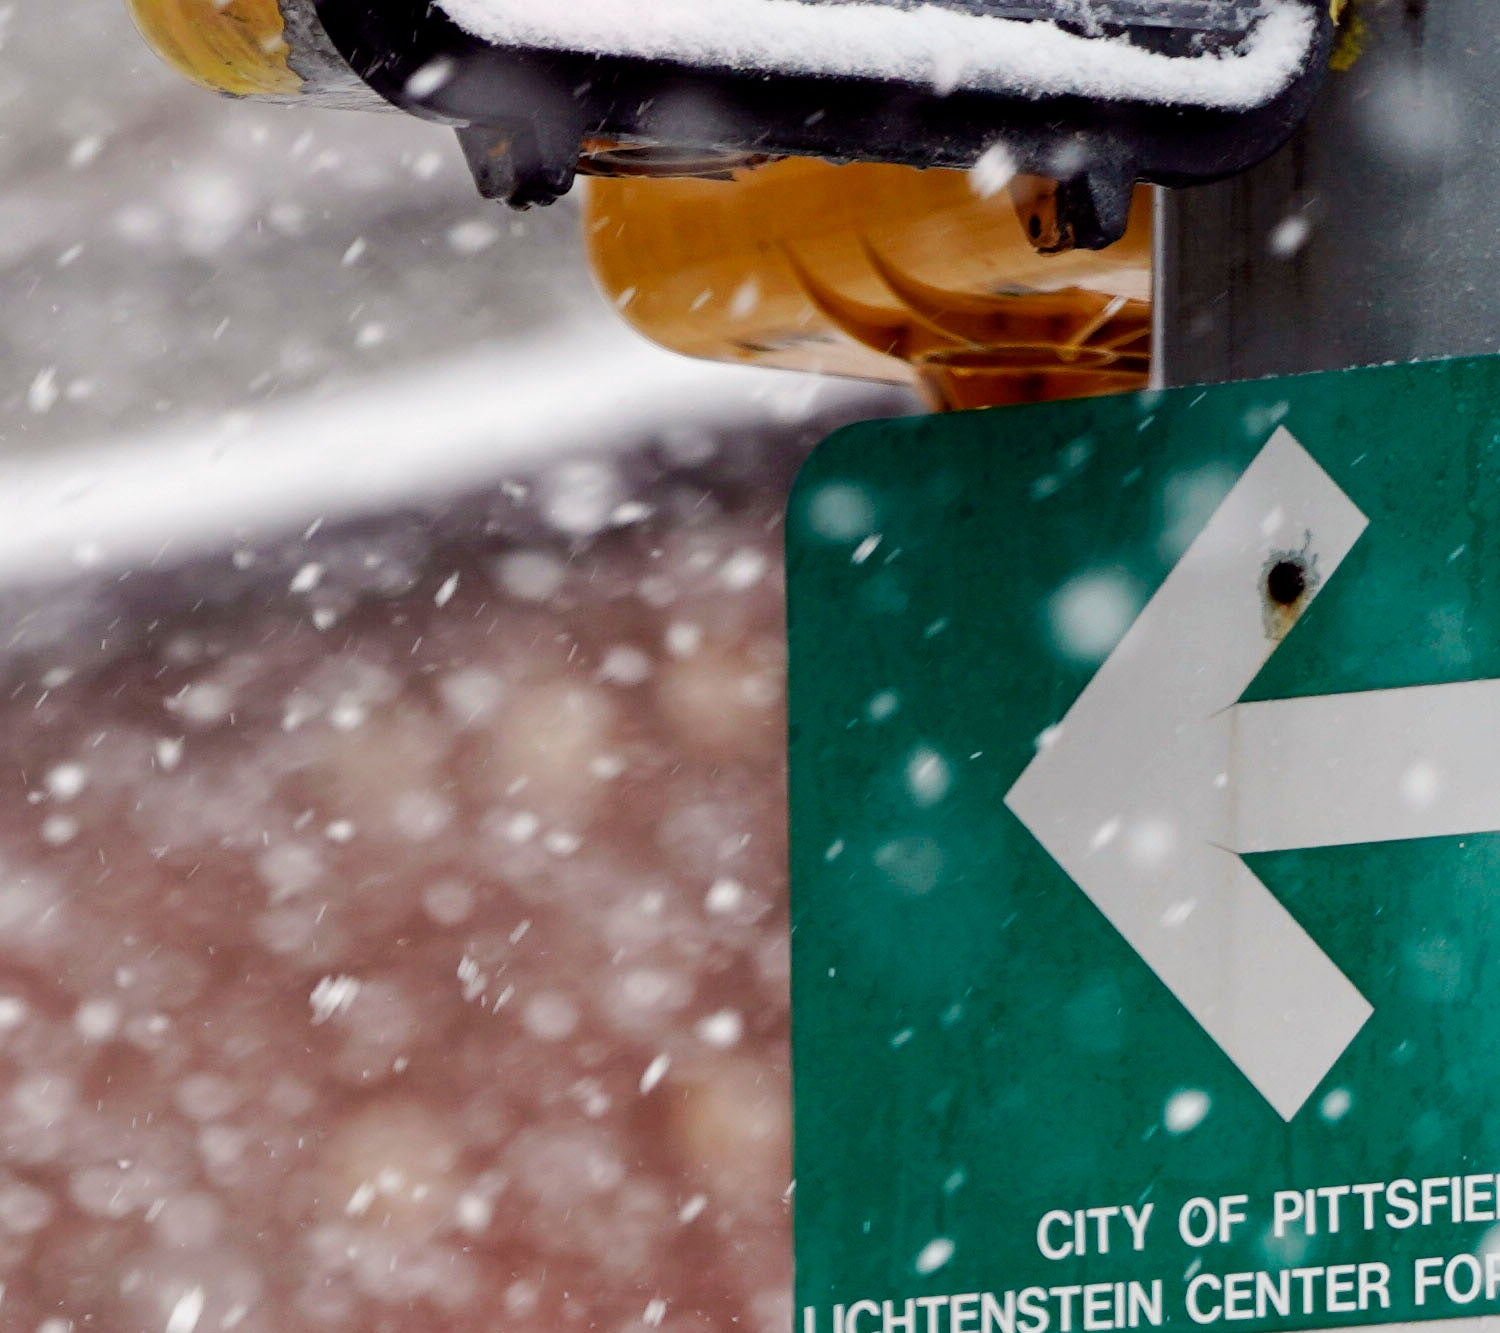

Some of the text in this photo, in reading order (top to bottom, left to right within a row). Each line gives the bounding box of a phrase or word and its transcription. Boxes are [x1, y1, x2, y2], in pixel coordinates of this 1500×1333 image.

[1036, 1202, 1154, 1261] CITY
[1178, 1193, 1249, 1248] OF
[1185, 1261, 1391, 1325] CENTER
